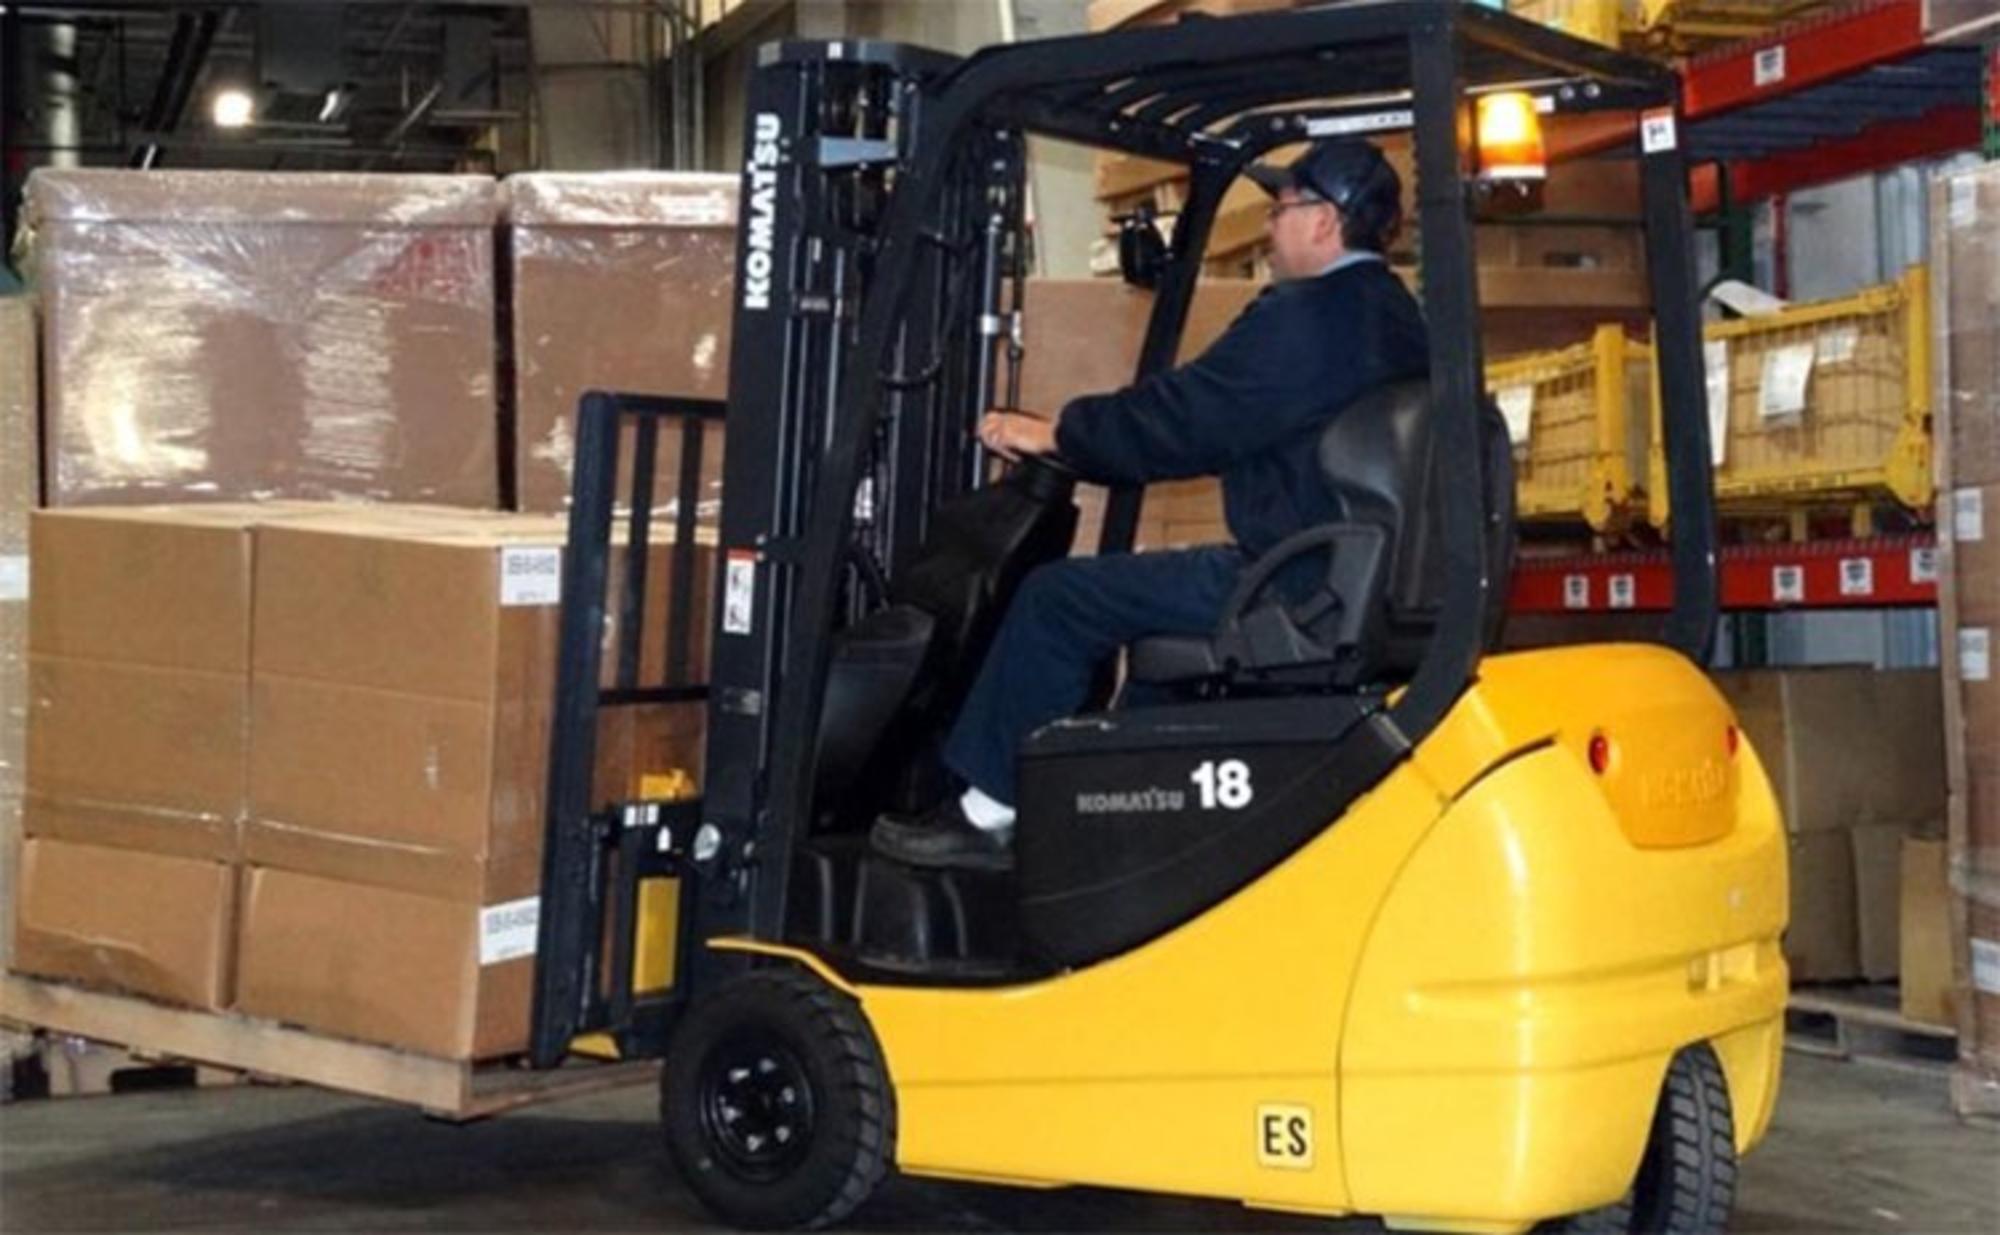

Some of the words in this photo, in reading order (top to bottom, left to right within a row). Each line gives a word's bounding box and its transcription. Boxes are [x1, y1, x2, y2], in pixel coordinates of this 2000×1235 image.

[744, 113, 781, 308] KOMATSU
[1077, 787, 1184, 812] KOMATSU
[1190, 759, 1253, 809] 18
[1263, 1115, 1307, 1158] ES
